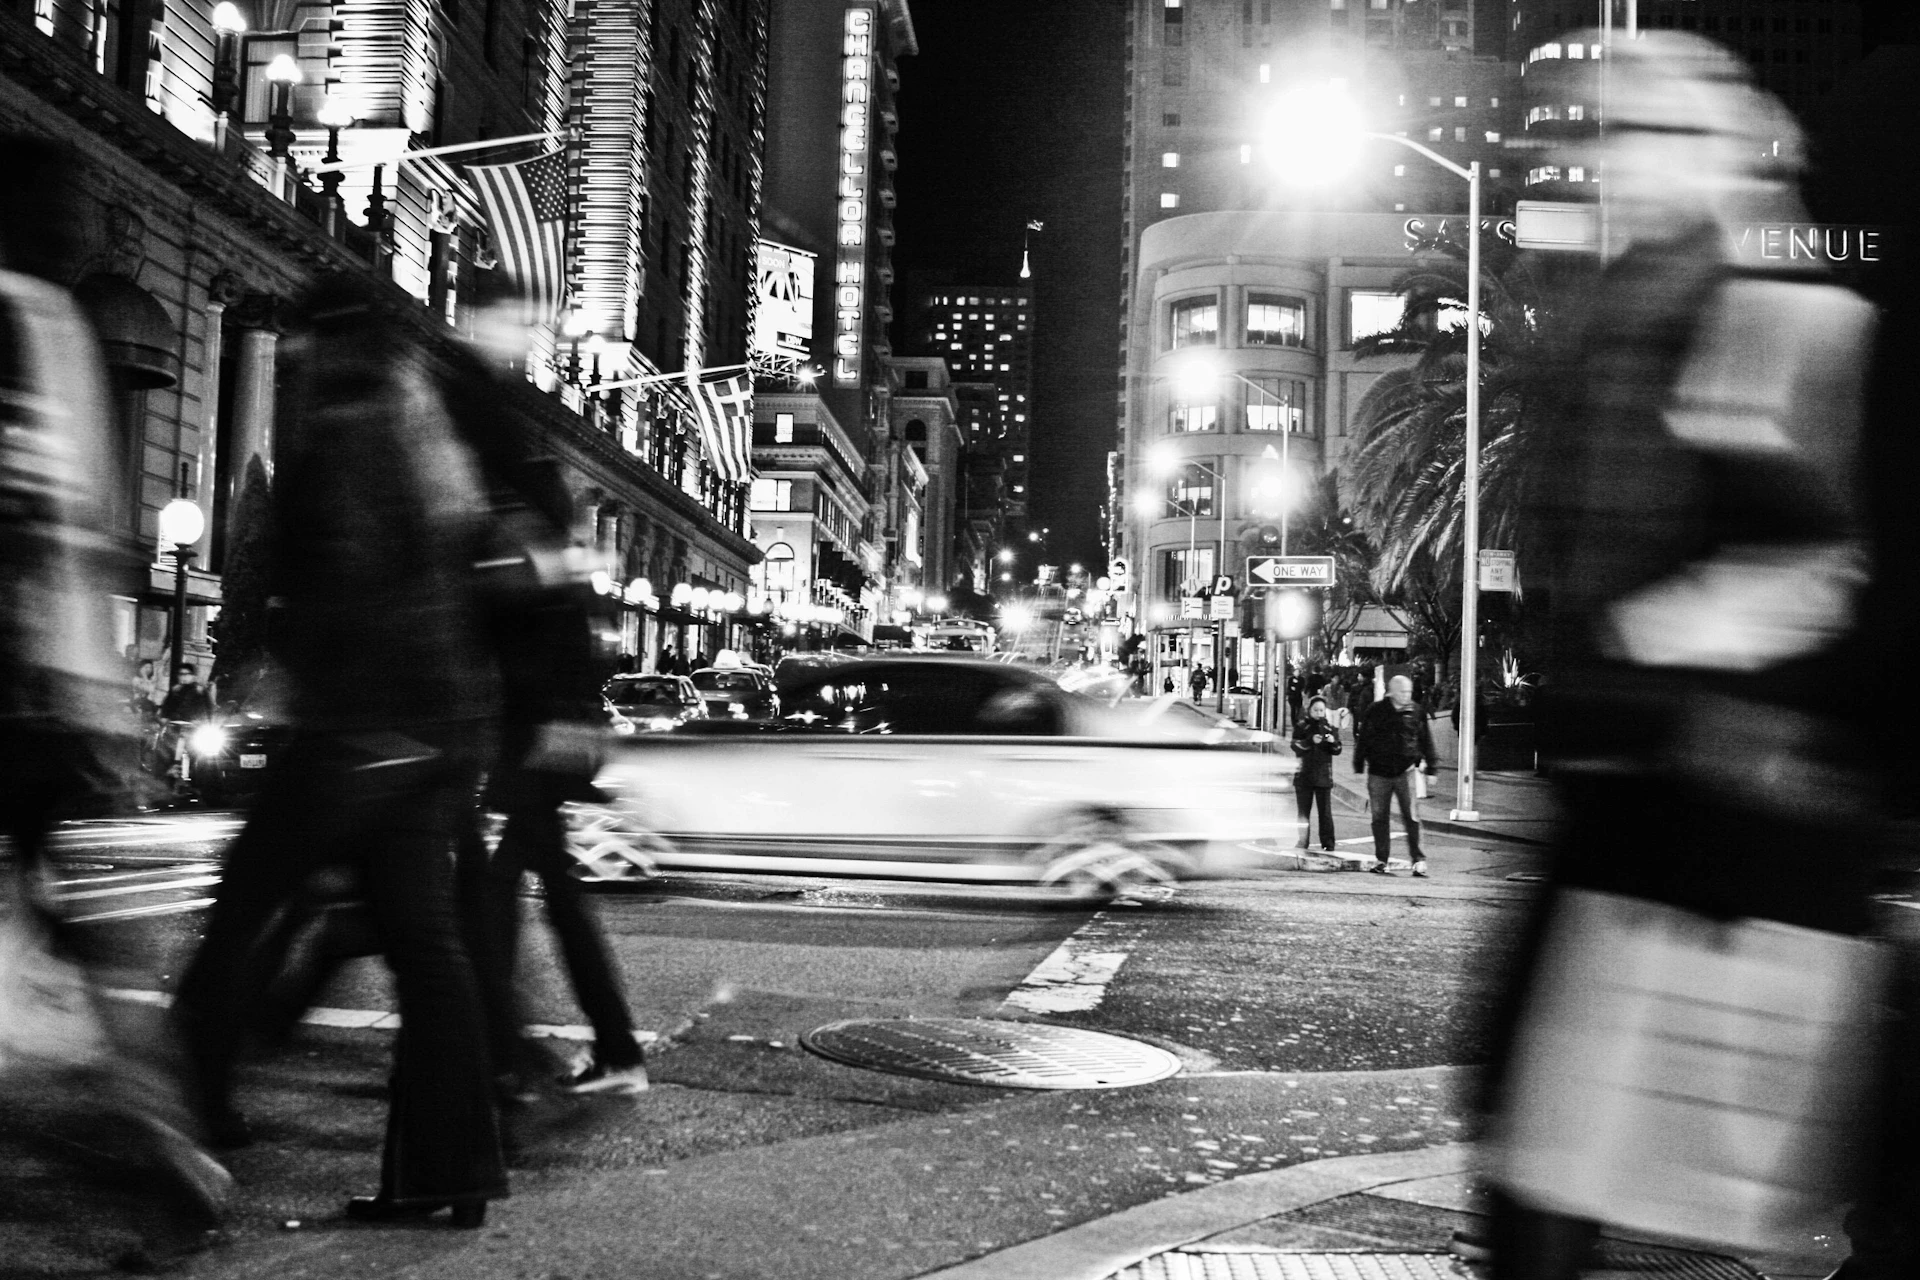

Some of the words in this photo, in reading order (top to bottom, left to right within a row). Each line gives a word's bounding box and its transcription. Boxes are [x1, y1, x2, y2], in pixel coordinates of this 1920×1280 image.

[840, 11, 871, 245] CHANCELLOR
[1404, 218, 1517, 251] SAS
[1726, 227, 1881, 262] VENUE
[761, 255, 786, 269] SOON
[836, 262, 861, 379] HOTEL
[1273, 565, 1296, 577] ONE
[1300, 566, 1324, 577] WAY
[1481, 557, 1490, 566] NO
